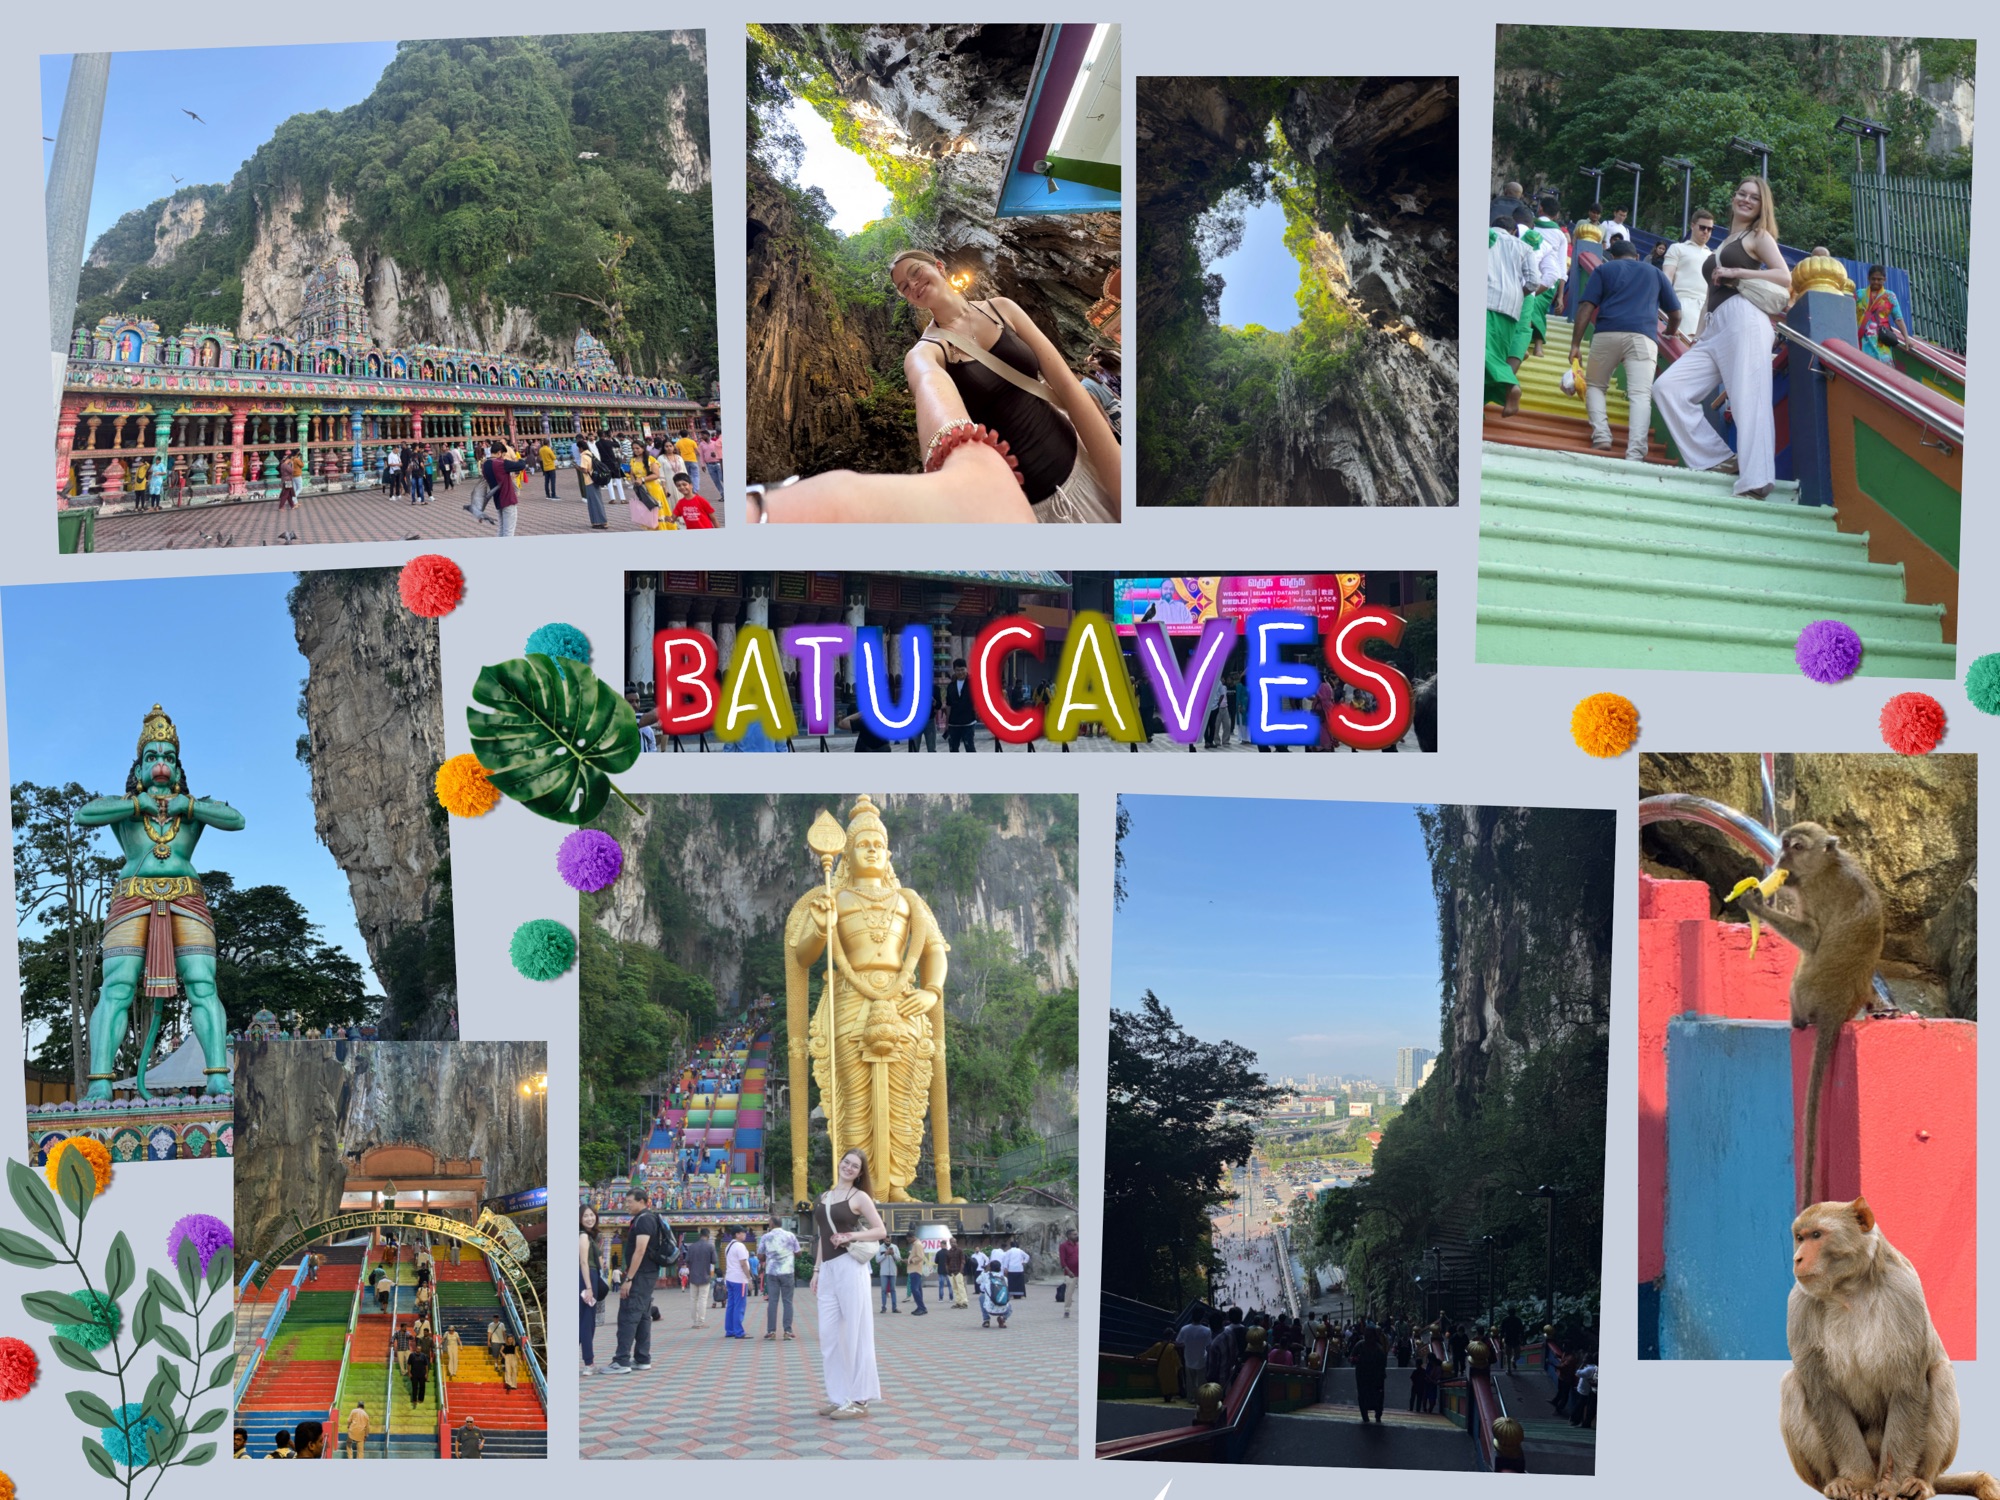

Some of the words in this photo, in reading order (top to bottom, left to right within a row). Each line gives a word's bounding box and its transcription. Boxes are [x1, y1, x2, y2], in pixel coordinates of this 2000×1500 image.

[653, 625, 934, 742] BATU
[969, 607, 1413, 749] CAVES
[921, 1239, 942, 1249] ONA
